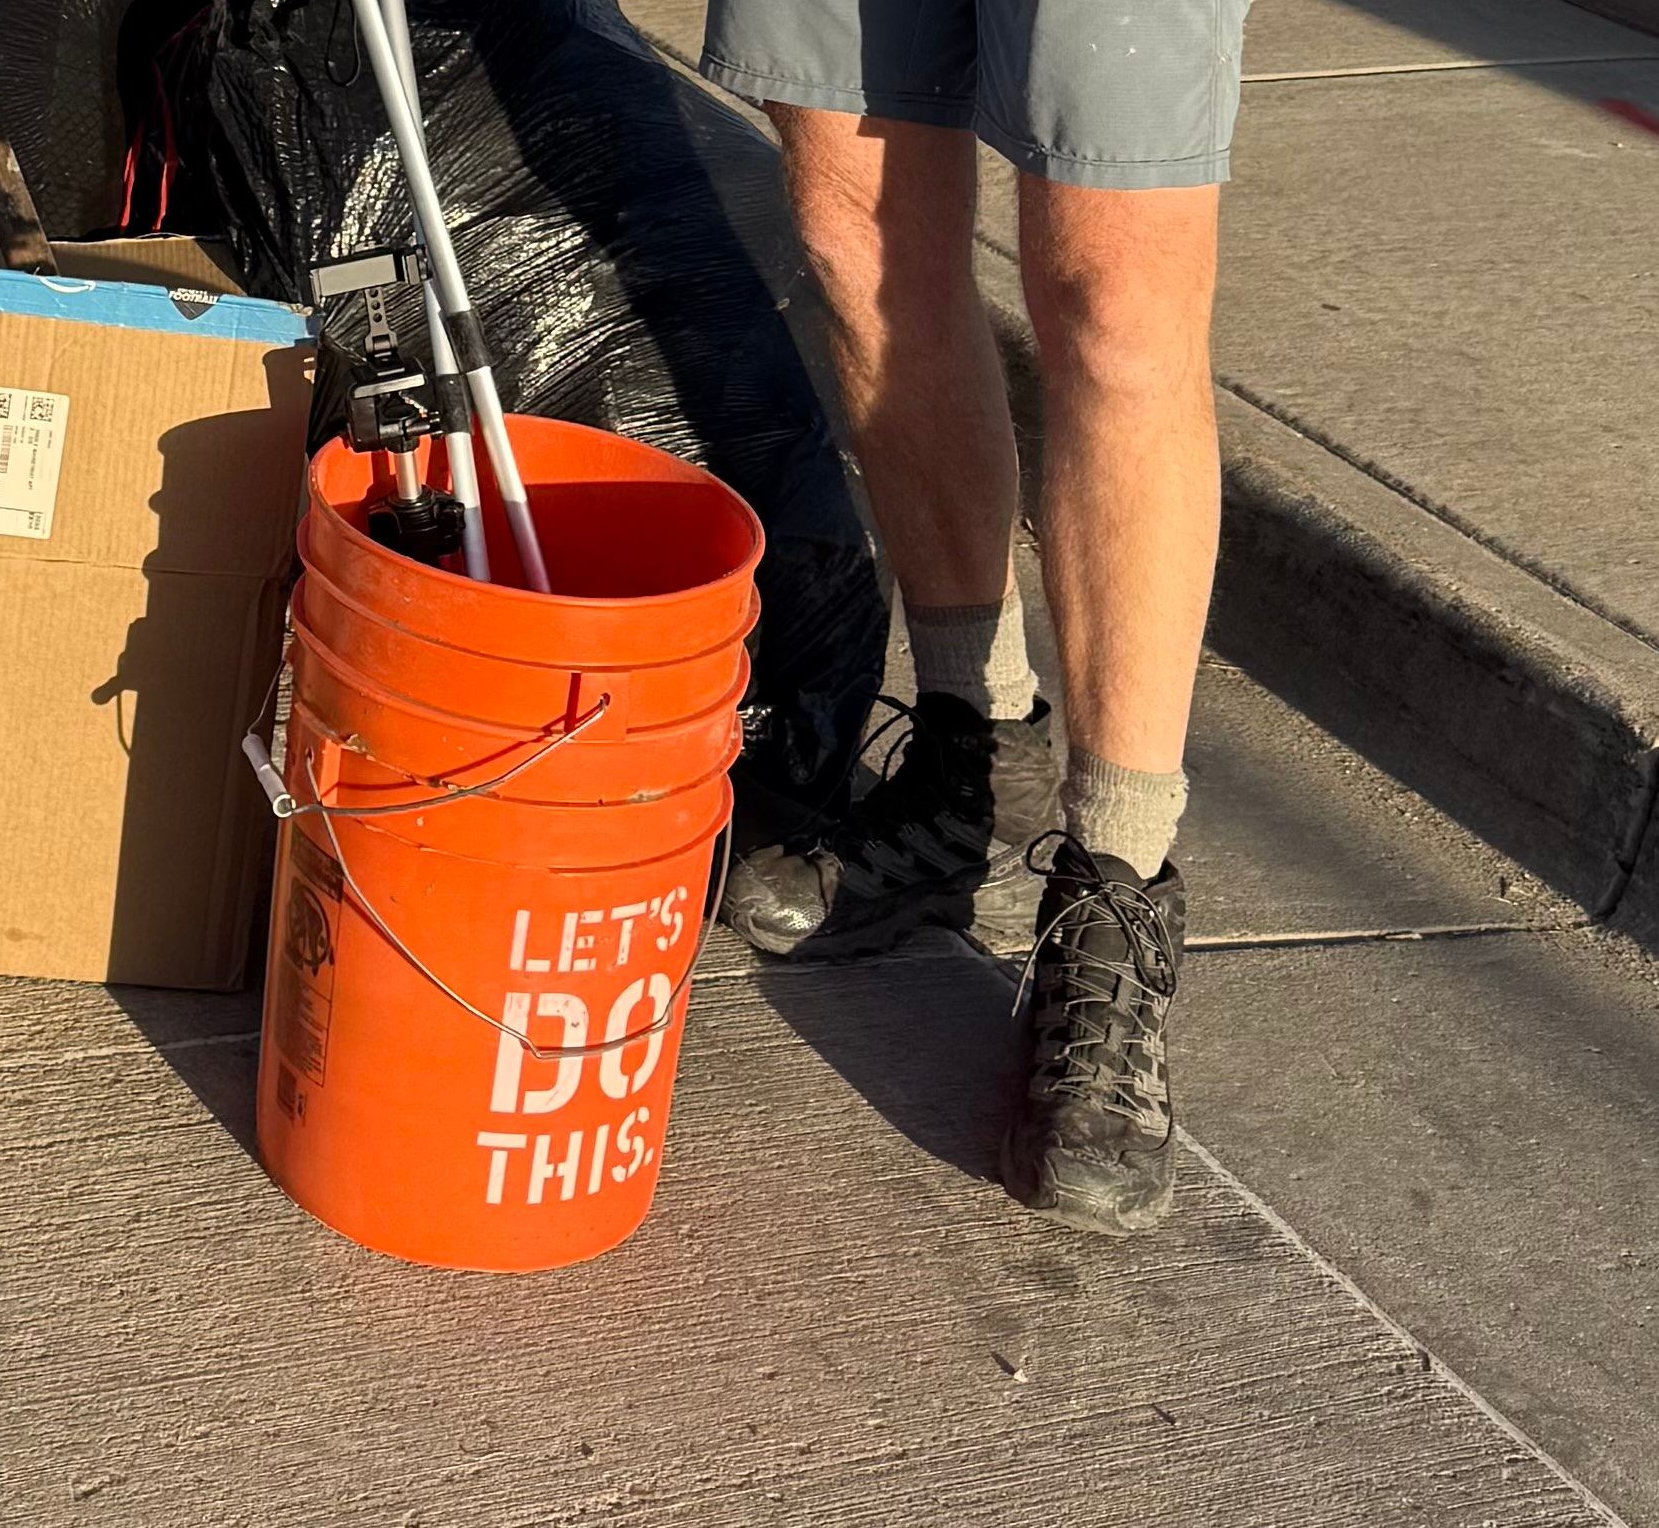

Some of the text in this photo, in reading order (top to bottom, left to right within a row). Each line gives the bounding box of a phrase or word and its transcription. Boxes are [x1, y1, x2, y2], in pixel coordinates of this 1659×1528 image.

[510, 886, 688, 972] LET'S
[490, 972, 672, 1114] DO
[476, 1107, 654, 1204] THIS.
